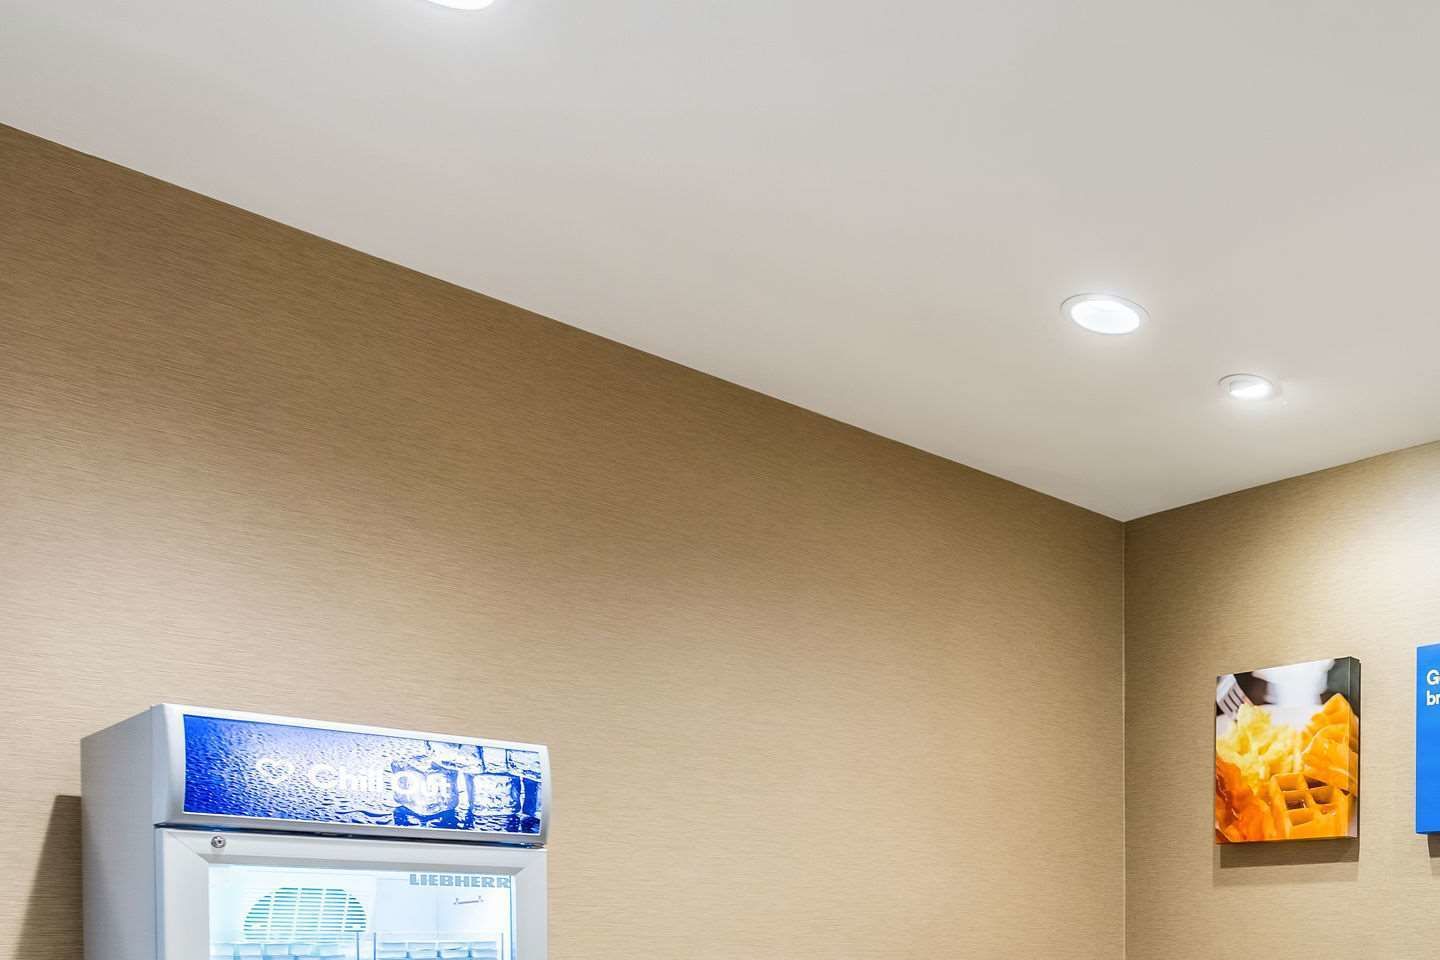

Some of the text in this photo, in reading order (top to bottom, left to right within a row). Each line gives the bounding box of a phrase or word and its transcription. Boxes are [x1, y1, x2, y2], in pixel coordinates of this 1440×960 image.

[308, 763, 451, 798] Chill Out
[409, 873, 512, 889] LIEBHERR
